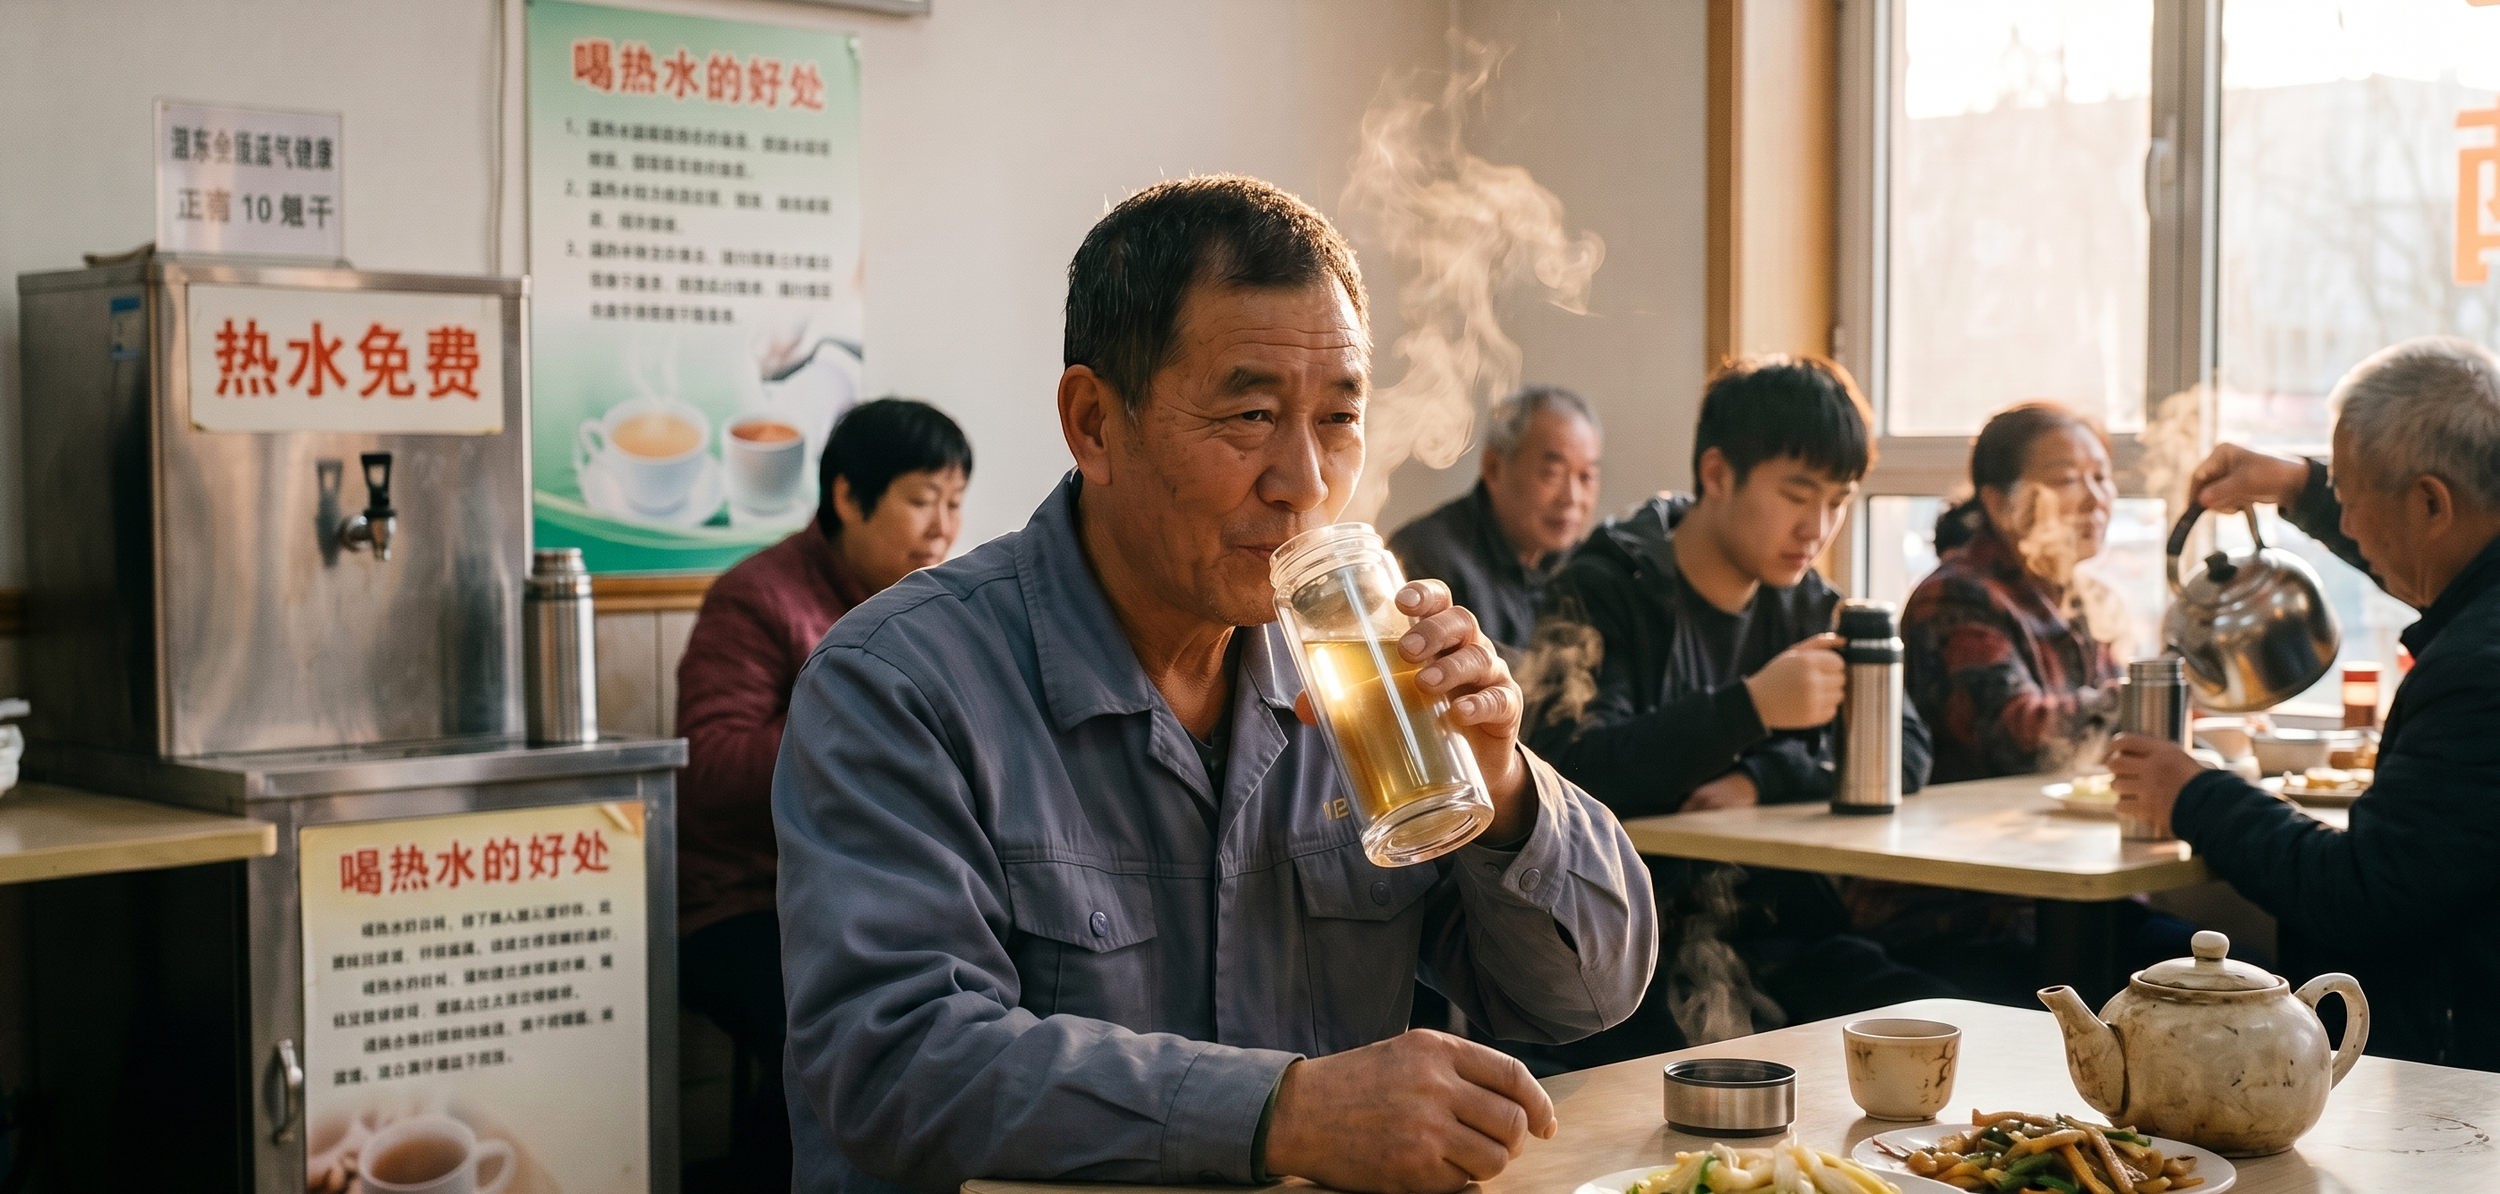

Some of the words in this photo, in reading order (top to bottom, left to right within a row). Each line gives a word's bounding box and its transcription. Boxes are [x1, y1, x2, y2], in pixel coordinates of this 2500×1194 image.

[573, 40, 825, 111] 喝热水的好处
[243, 194, 272, 224] 10
[214, 318, 480, 400] 热水免费
[339, 829, 611, 895] 喝热水的好处
